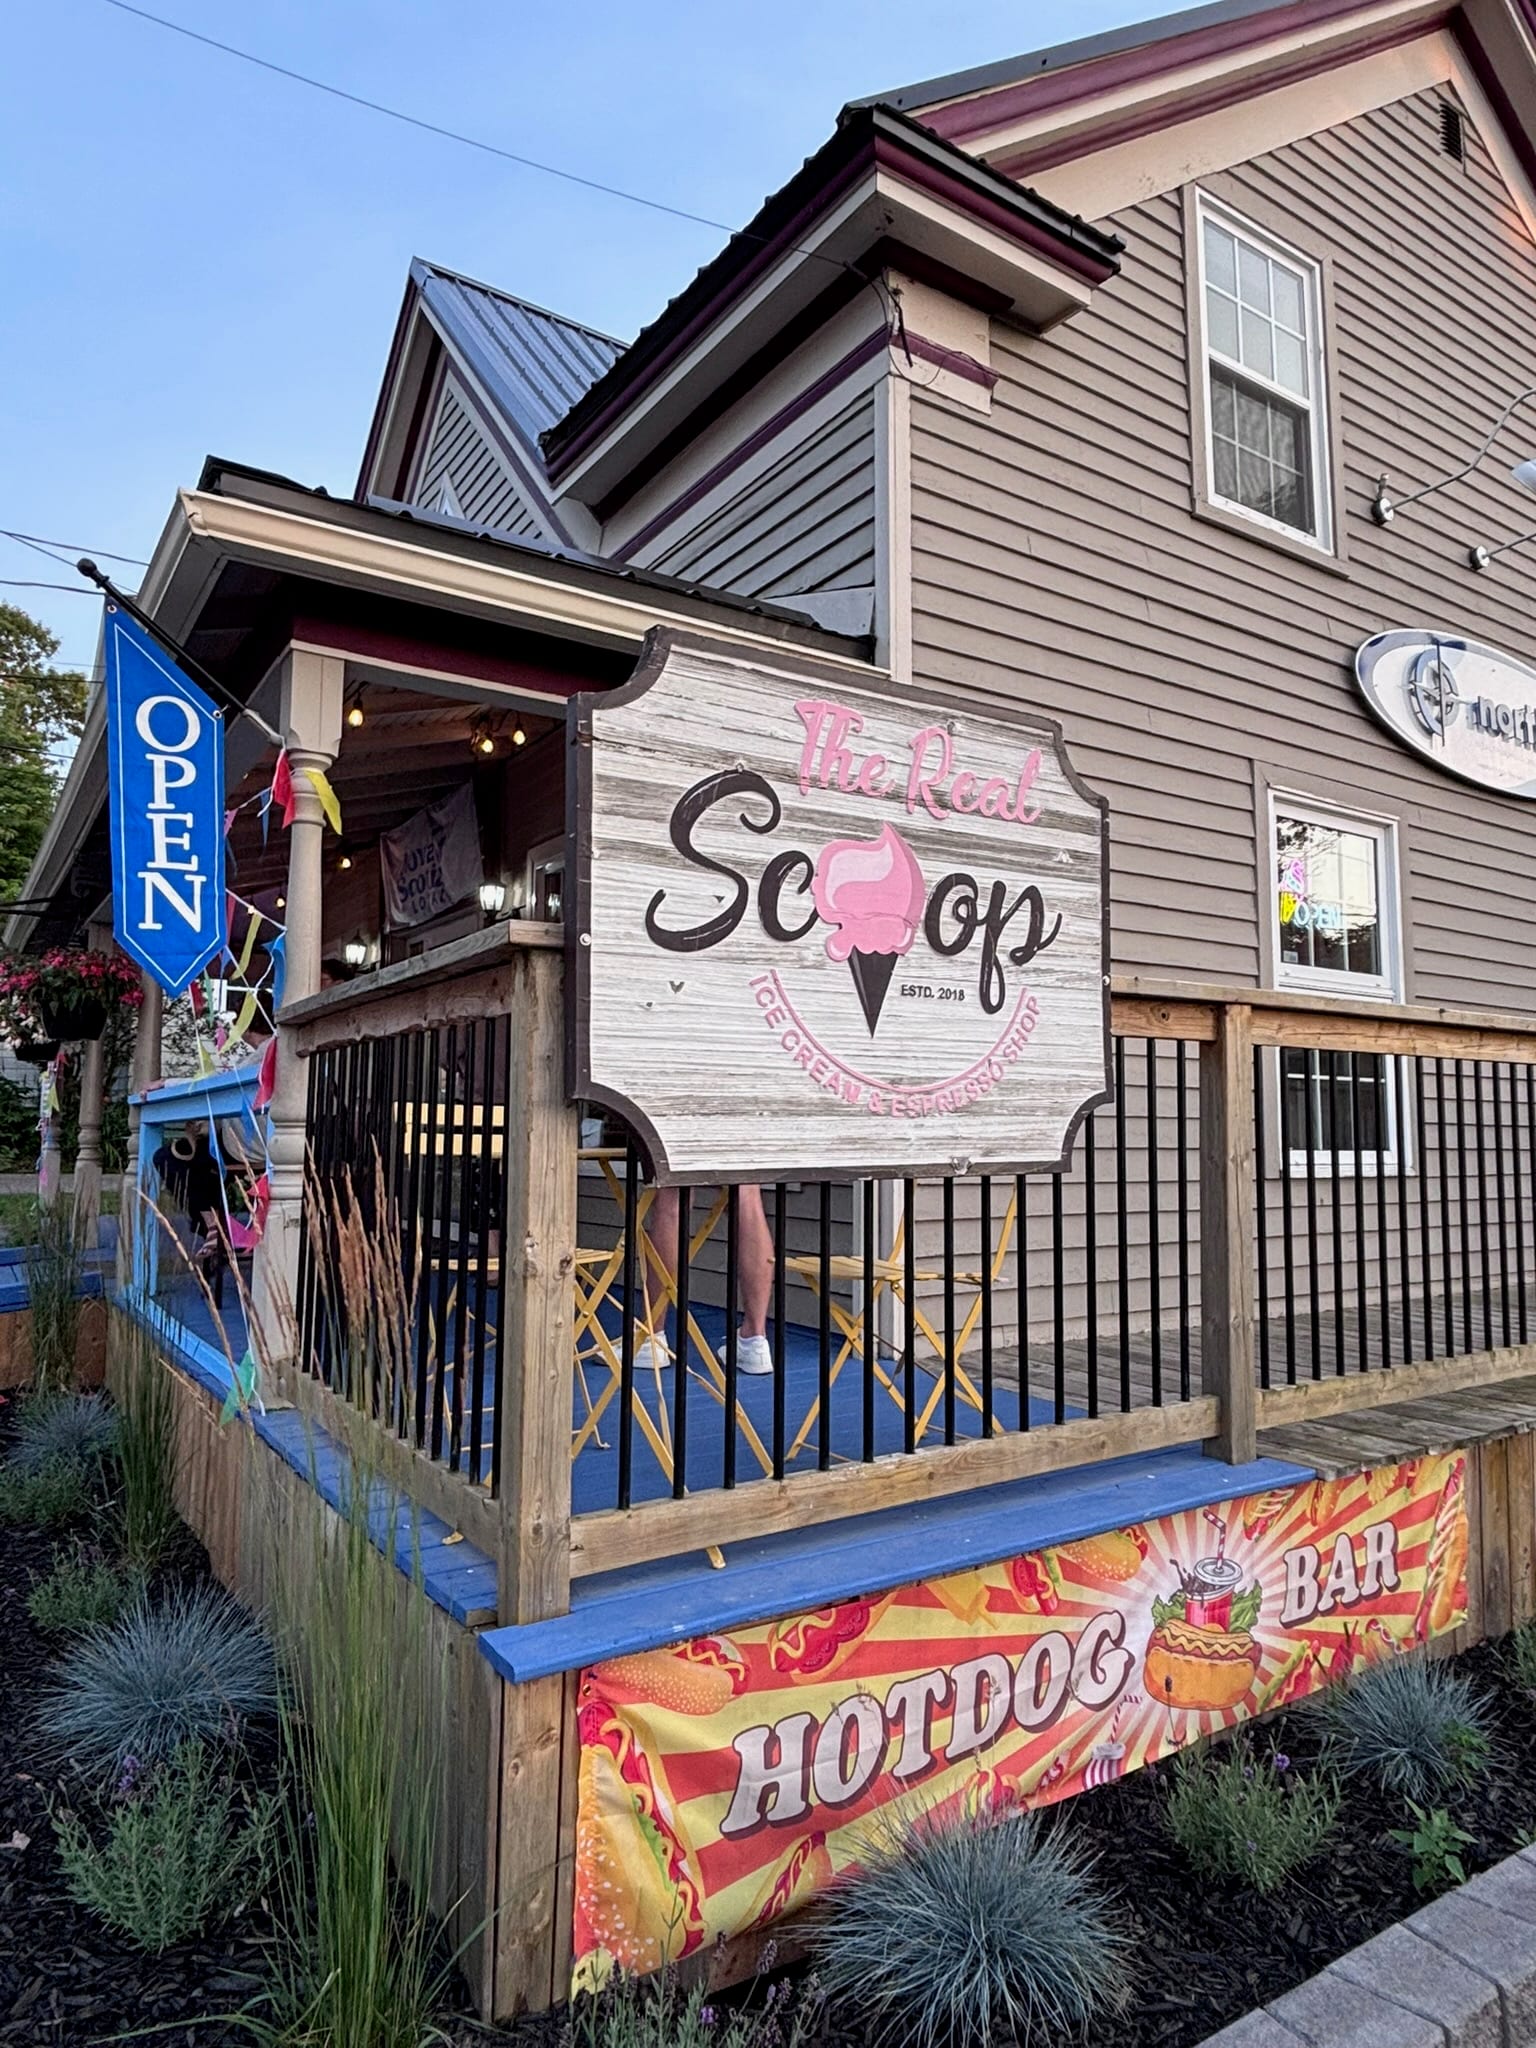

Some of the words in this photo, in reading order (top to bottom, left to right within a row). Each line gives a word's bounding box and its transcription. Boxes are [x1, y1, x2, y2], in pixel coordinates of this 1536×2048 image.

[794, 699, 896, 796] The
[905, 726, 1043, 824] Real
[1474, 695, 1536, 749] nort
[135, 694, 207, 933] OPEN
[645, 768, 1063, 1015] Scop
[1294, 900, 1342, 929] OPEN
[749, 974, 787, 1029] ICE
[780, 1028, 862, 1104] CREAM
[868, 1092, 882, 1114] &
[890, 1060, 1004, 1119] ESPRESSO
[1003, 995, 1041, 1065] SHOP
[901, 983, 935, 999] ESTD.
[937, 986, 965, 1001] 2018
[720, 1611, 1136, 1839] HOTDOG
[1279, 1519, 1402, 1628] BAR
